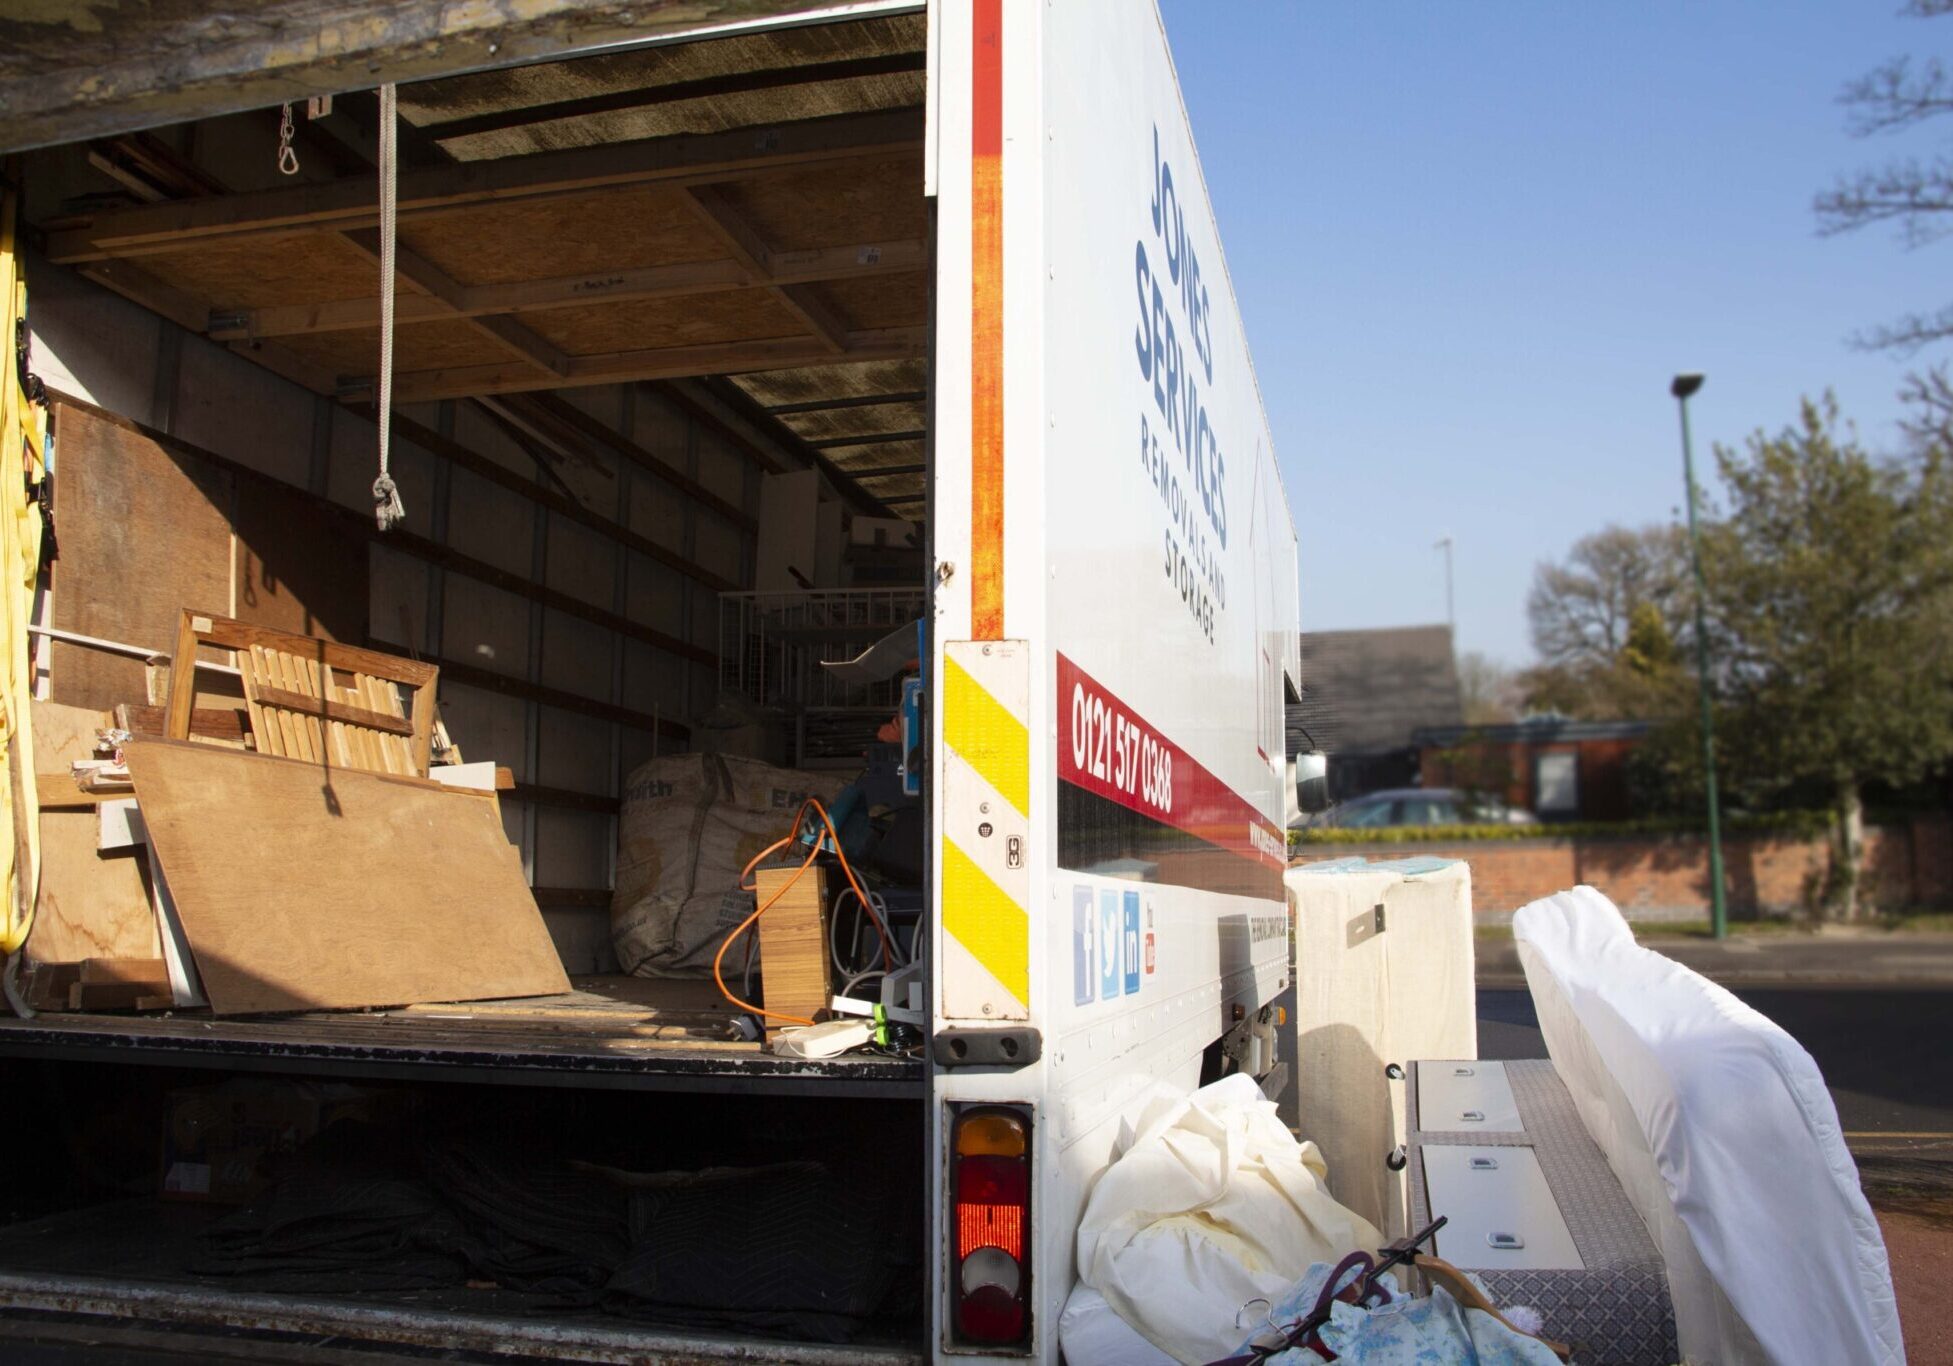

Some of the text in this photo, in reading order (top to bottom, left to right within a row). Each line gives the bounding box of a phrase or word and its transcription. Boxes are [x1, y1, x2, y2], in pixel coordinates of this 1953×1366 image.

[1151, 120, 1212, 387] JONES
[1135, 239, 1227, 551] SERVICES
[1141, 411, 1226, 611] REMOVALS AND
[1165, 527, 1214, 646] STORAGE
[1072, 682, 1172, 814] 0121 517 0368
